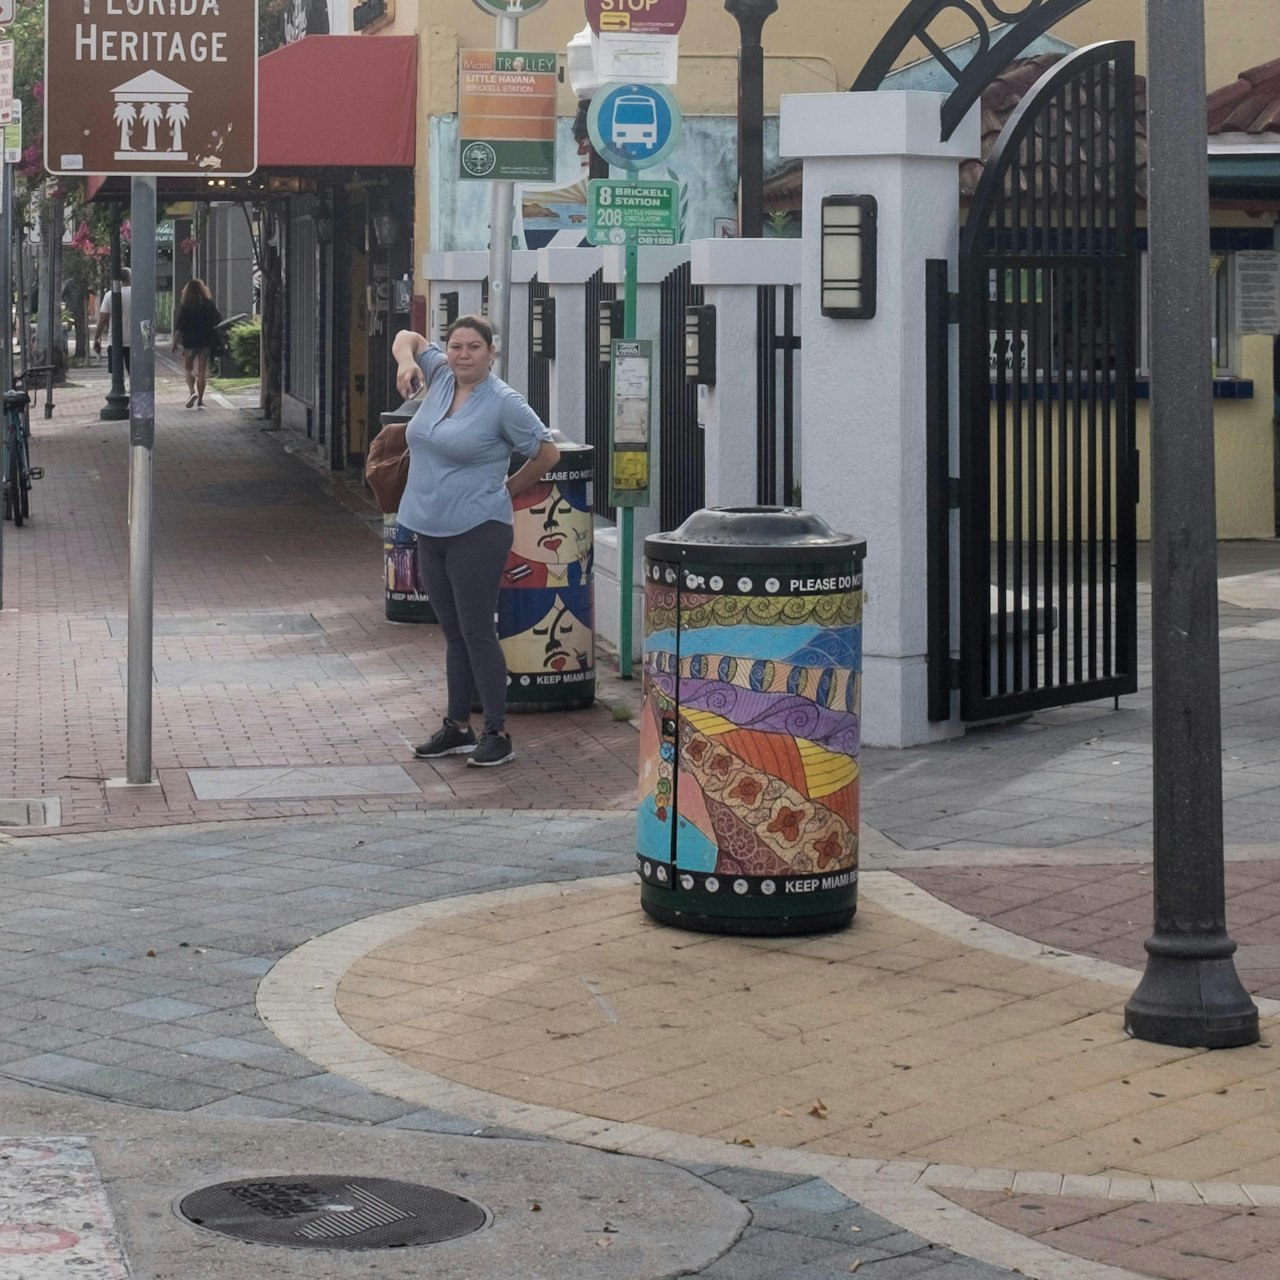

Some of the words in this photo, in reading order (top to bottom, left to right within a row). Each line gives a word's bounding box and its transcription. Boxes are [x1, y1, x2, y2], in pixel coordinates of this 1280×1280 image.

[75, 23, 228, 62] HERITAGE
[463, 60, 492, 70] Miami
[466, 75, 497, 83] LITTLE
[498, 76, 536, 84] HAVANA
[599, 187, 612, 206] 8
[615, 187, 670, 197] BRICKELL
[614, 197, 660, 206] STATION
[597, 209, 622, 226] 208
[540, 472, 568, 481] EASE
[569, 470, 579, 480] DO
[790, 577, 837, 592] PLEASE
[838, 576, 851, 589] DO
[392, 592, 406, 600] KEEP
[407, 593, 429, 601] MIAMI
[536, 675, 562, 685] KEEP
[563, 672, 585, 682] MIAMI
[785, 879, 820, 893] KEEP
[822, 874, 849, 890] MIAMI
